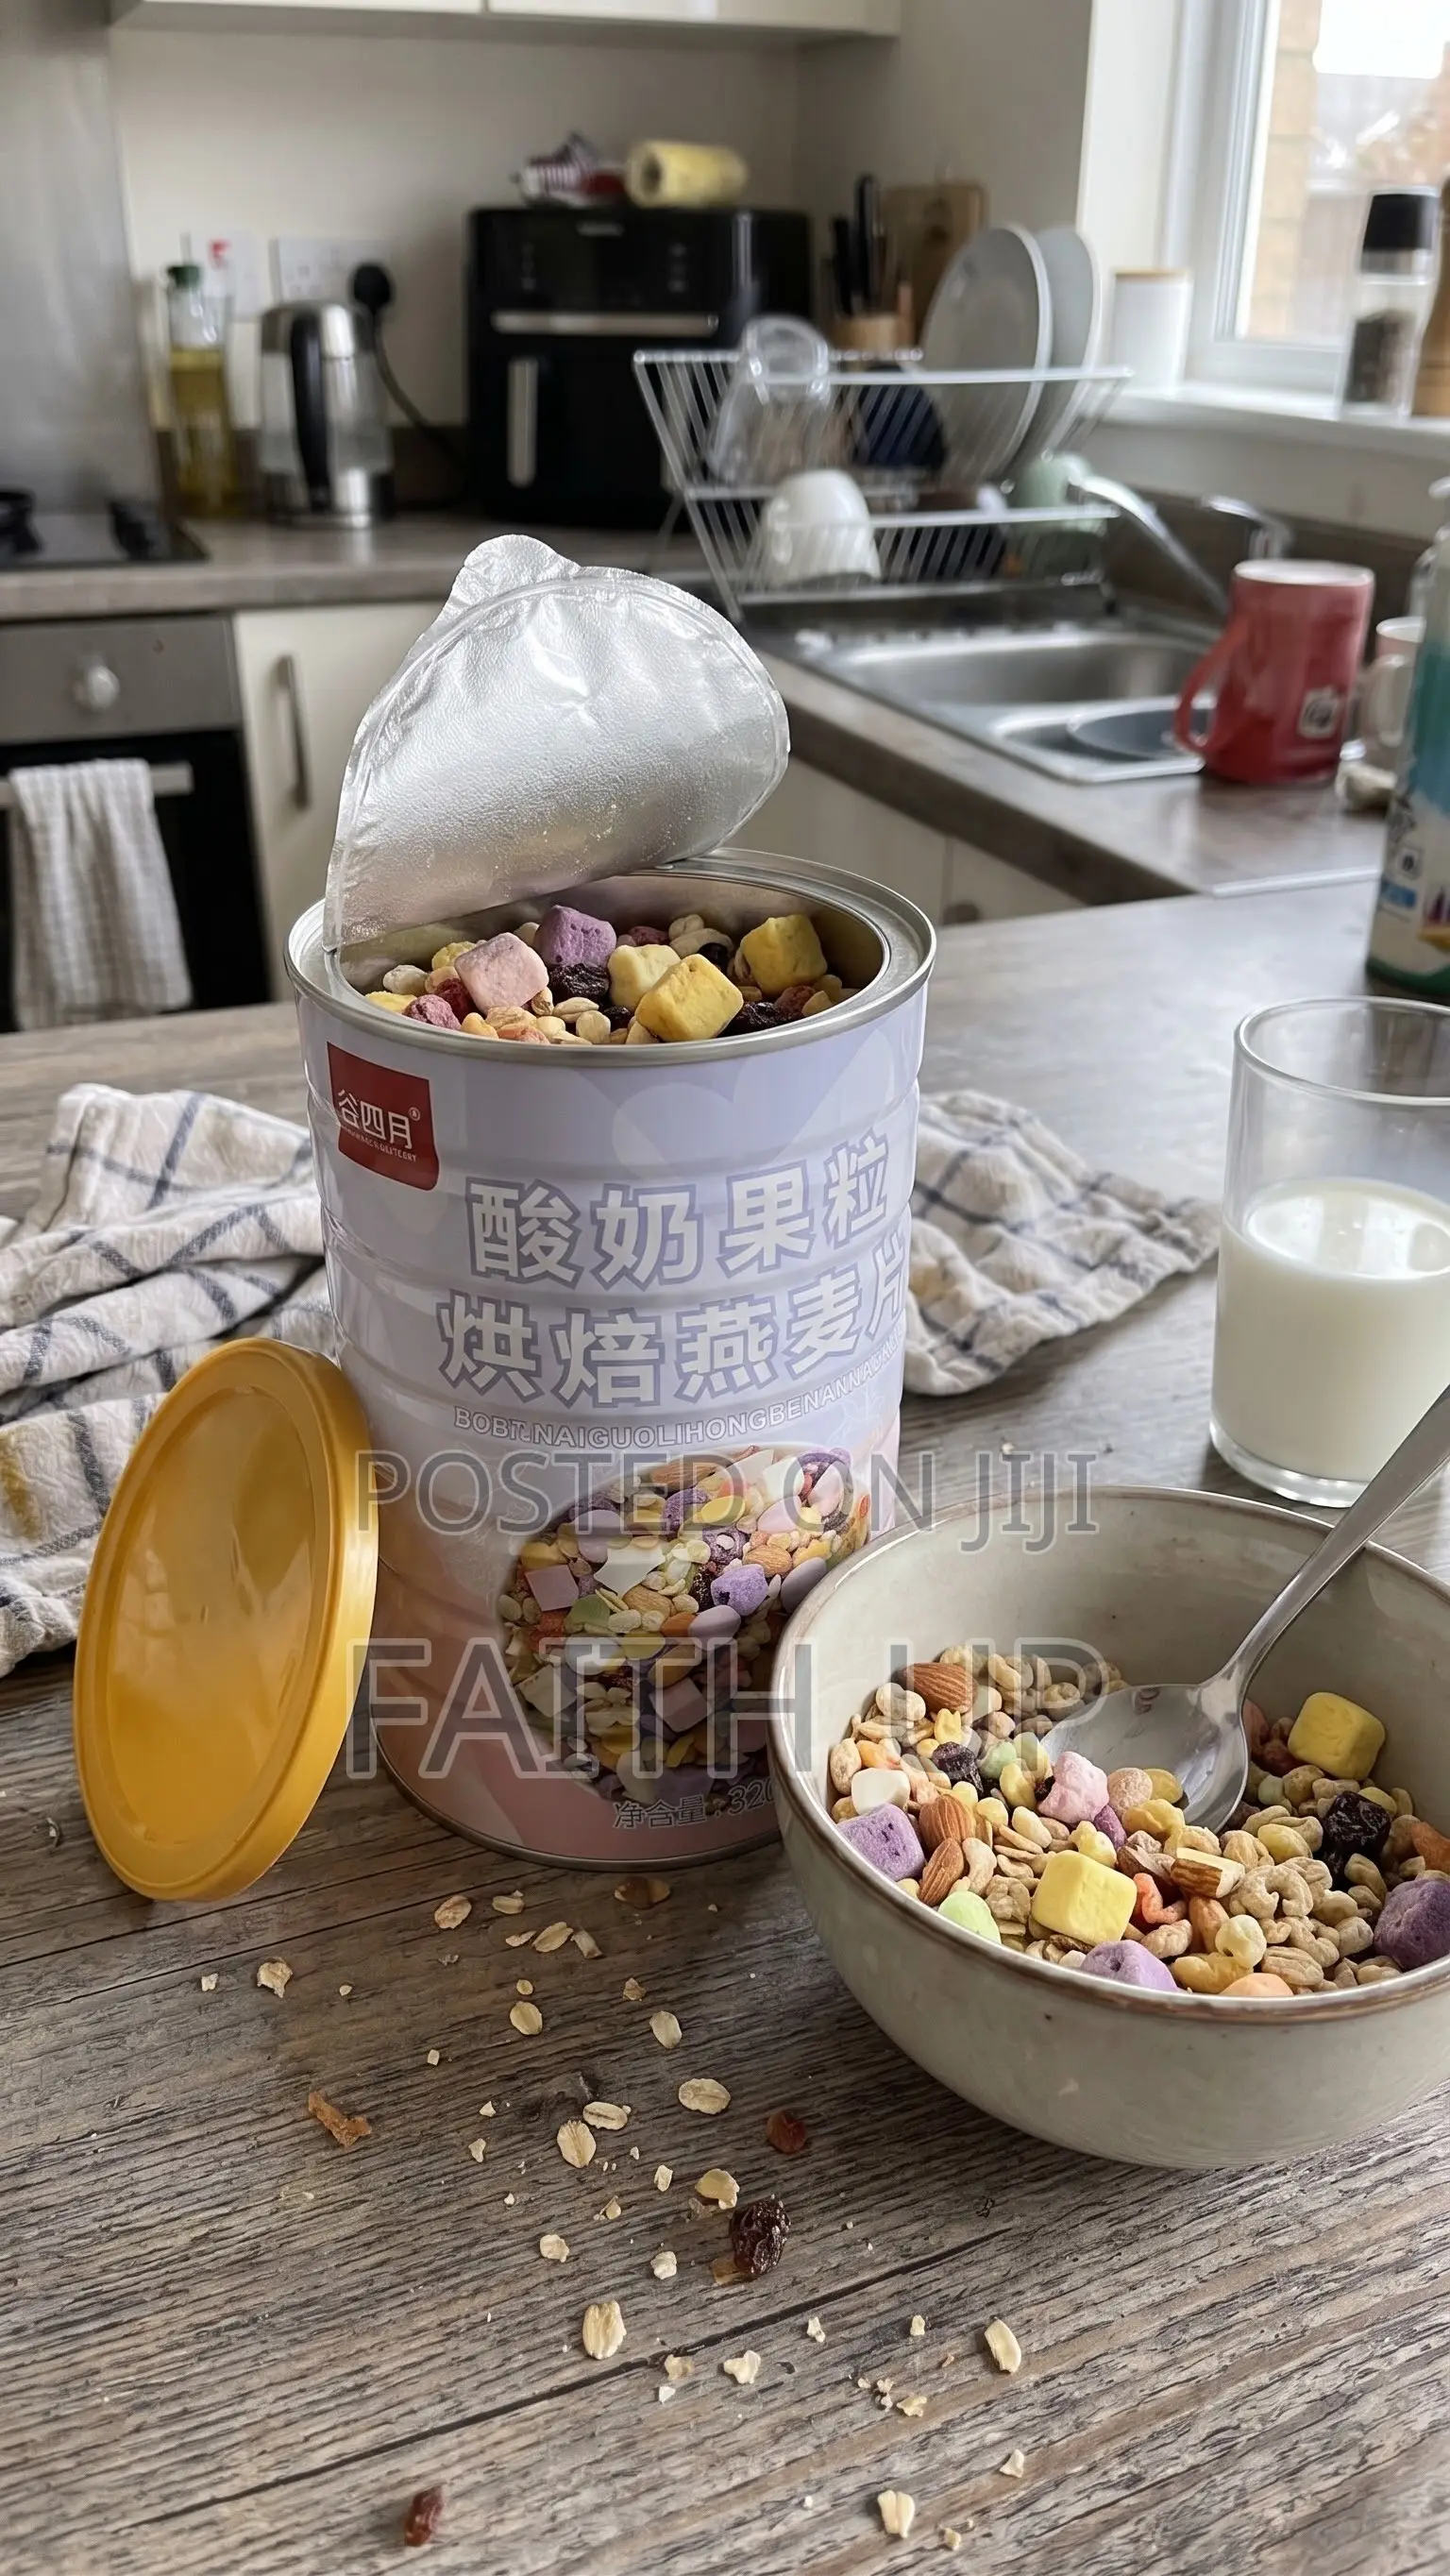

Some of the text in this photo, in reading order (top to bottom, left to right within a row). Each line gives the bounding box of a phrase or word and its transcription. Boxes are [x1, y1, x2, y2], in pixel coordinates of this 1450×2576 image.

[338, 1089, 413, 1150] 谷四月
[465, 1128, 889, 1290] 酸奶果粒
[437, 1229, 904, 1409] 烘焙燕麦片
